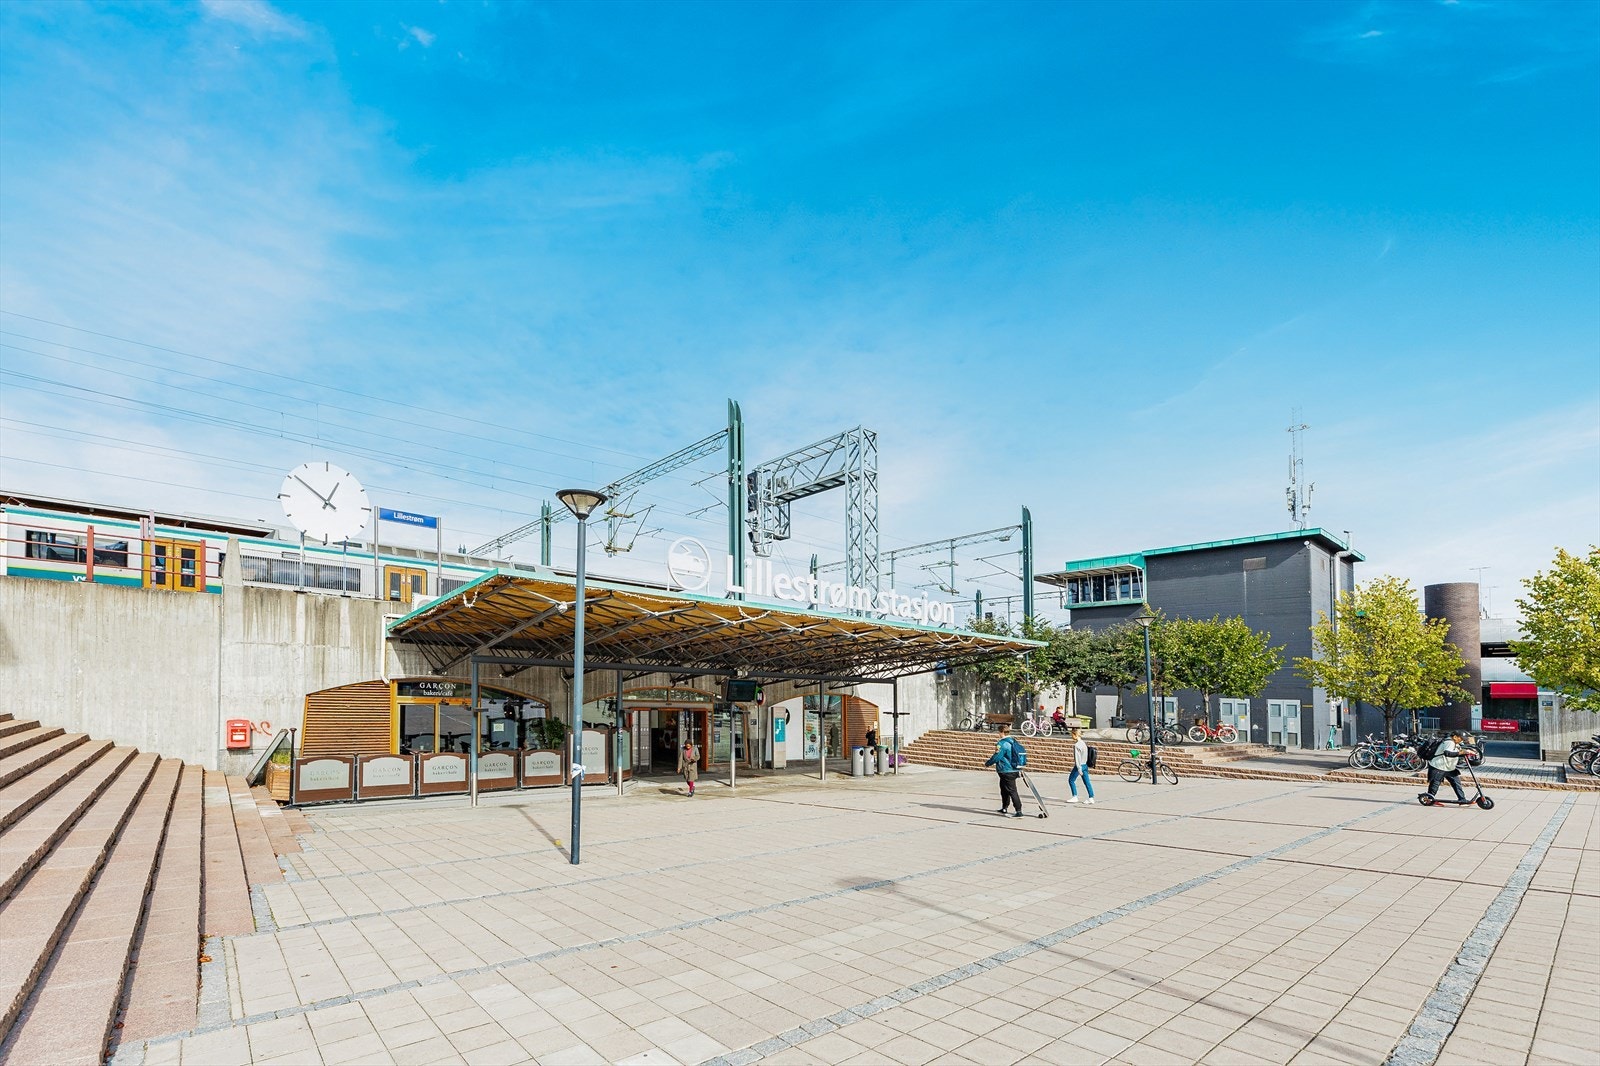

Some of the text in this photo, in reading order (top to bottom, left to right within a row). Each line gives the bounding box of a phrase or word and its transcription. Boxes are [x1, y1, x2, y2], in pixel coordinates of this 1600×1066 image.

[393, 511, 424, 523] Lillestrøm
[727, 555, 955, 625] Lillestrøm stasjon
[419, 682, 457, 690] GARÇON
